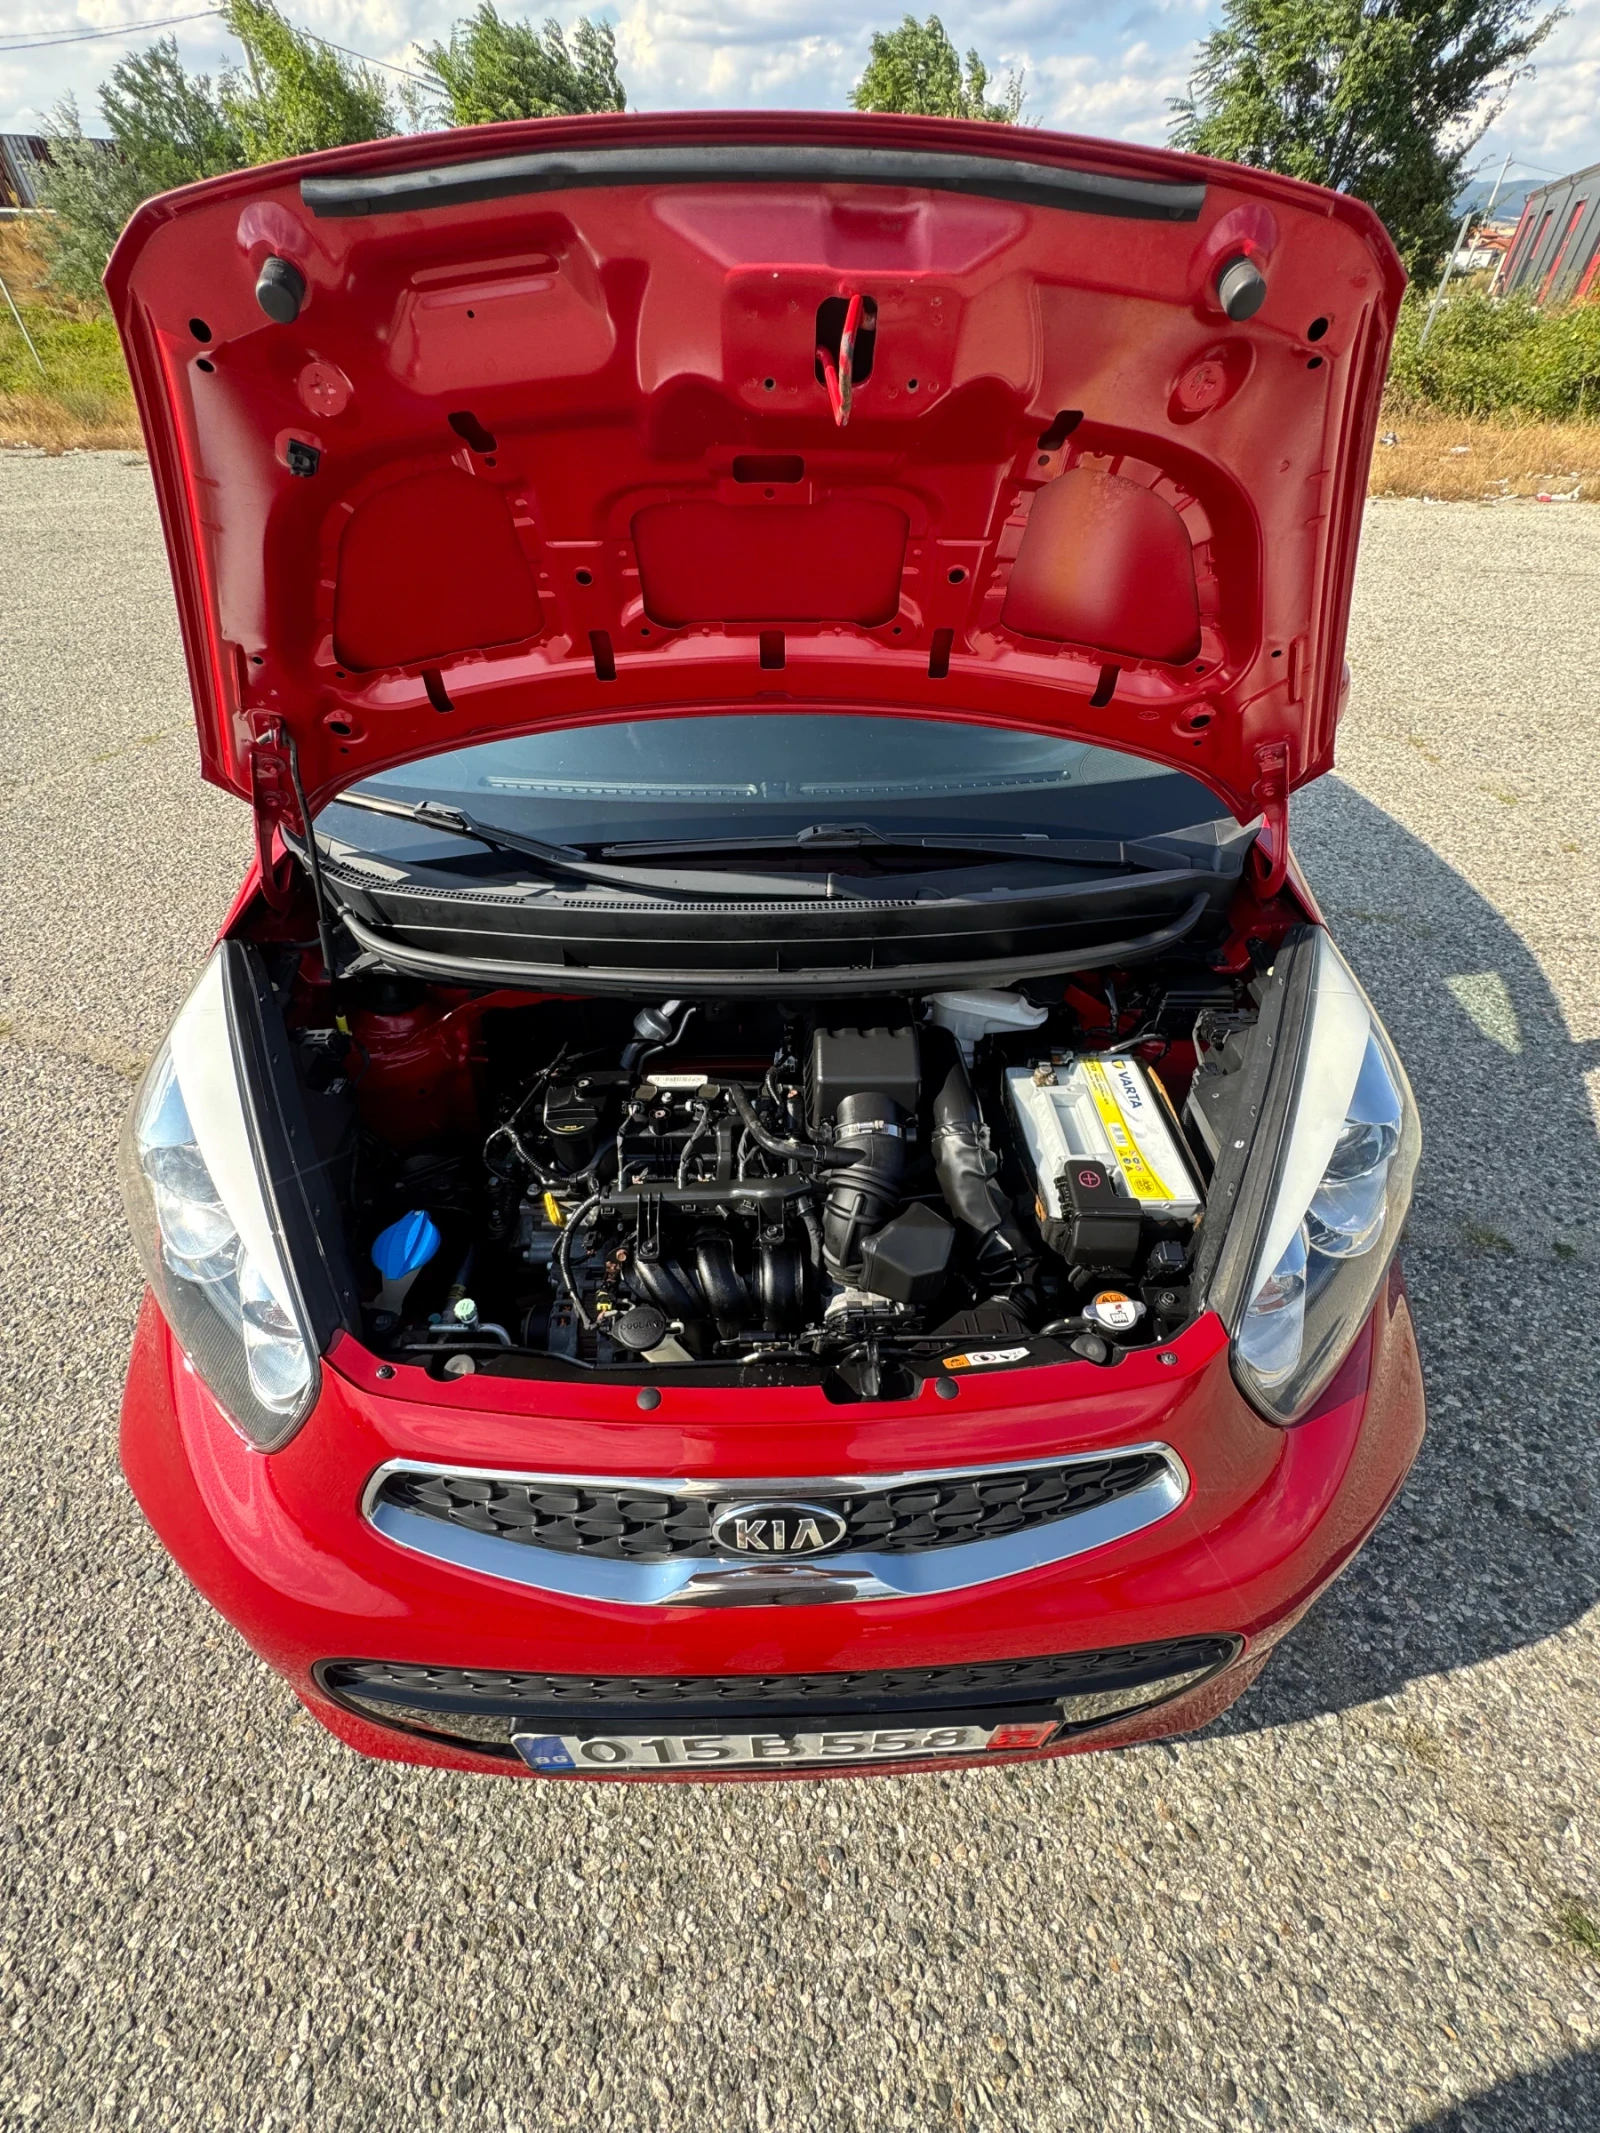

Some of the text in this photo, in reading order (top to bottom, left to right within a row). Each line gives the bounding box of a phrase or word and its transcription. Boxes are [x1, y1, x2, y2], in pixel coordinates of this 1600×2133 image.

[1118, 1071, 1142, 1108] VARTA
[734, 1518, 824, 1550] KIA
[820, 1728, 968, 1755] 558
[534, 1755, 568, 1764] BG
